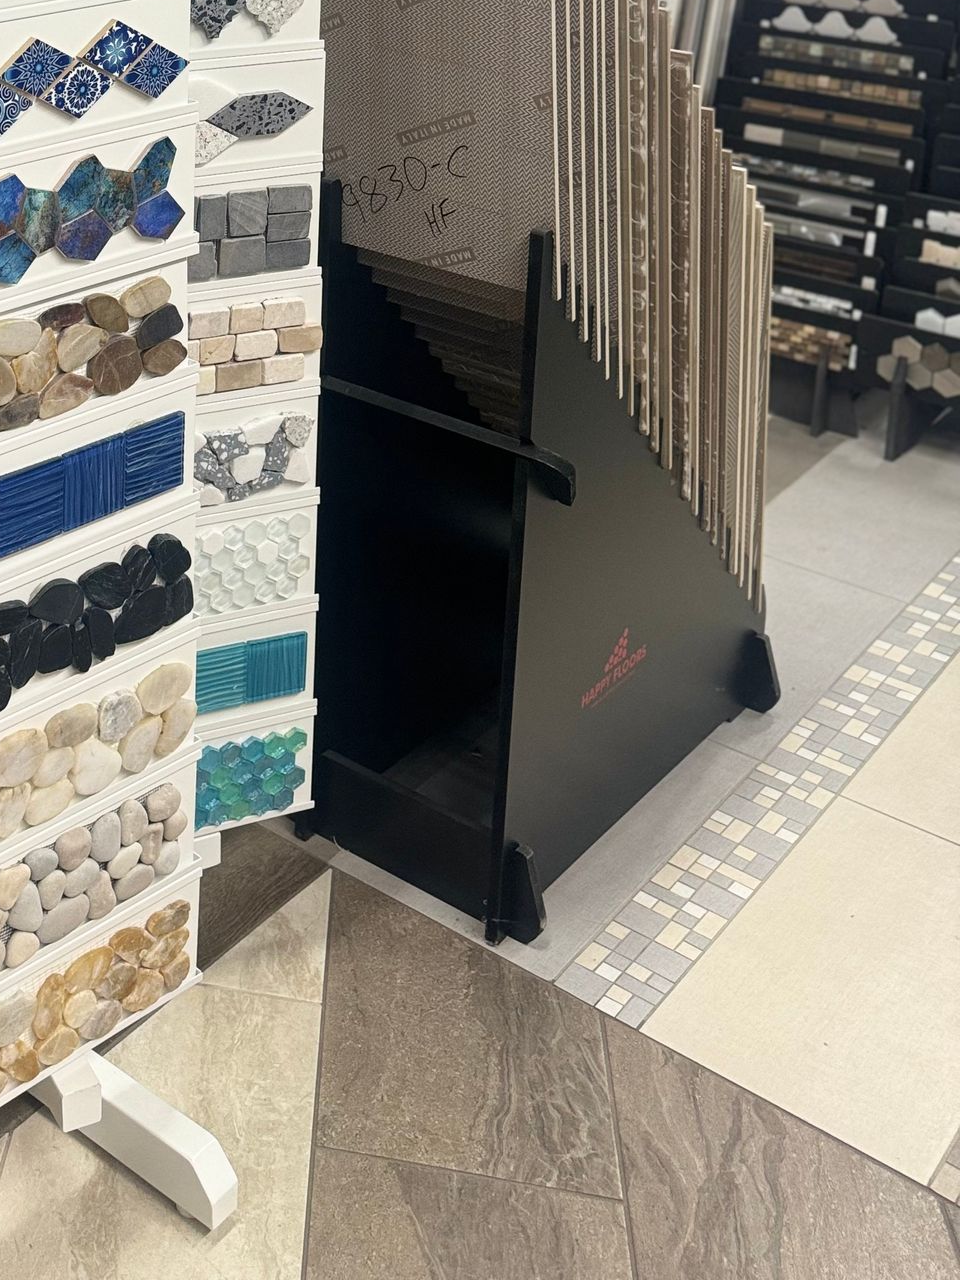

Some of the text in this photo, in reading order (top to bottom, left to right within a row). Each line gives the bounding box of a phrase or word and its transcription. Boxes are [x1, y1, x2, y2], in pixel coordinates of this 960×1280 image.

[401, 113, 472, 144] MADE IN ITALY
[341, 145, 469, 221] 9830-C
[423, 197, 457, 238] HF
[444, 250, 472, 265] MADE
[581, 672, 613, 710] HAPPY
[612, 647, 648, 682] FLOORS
